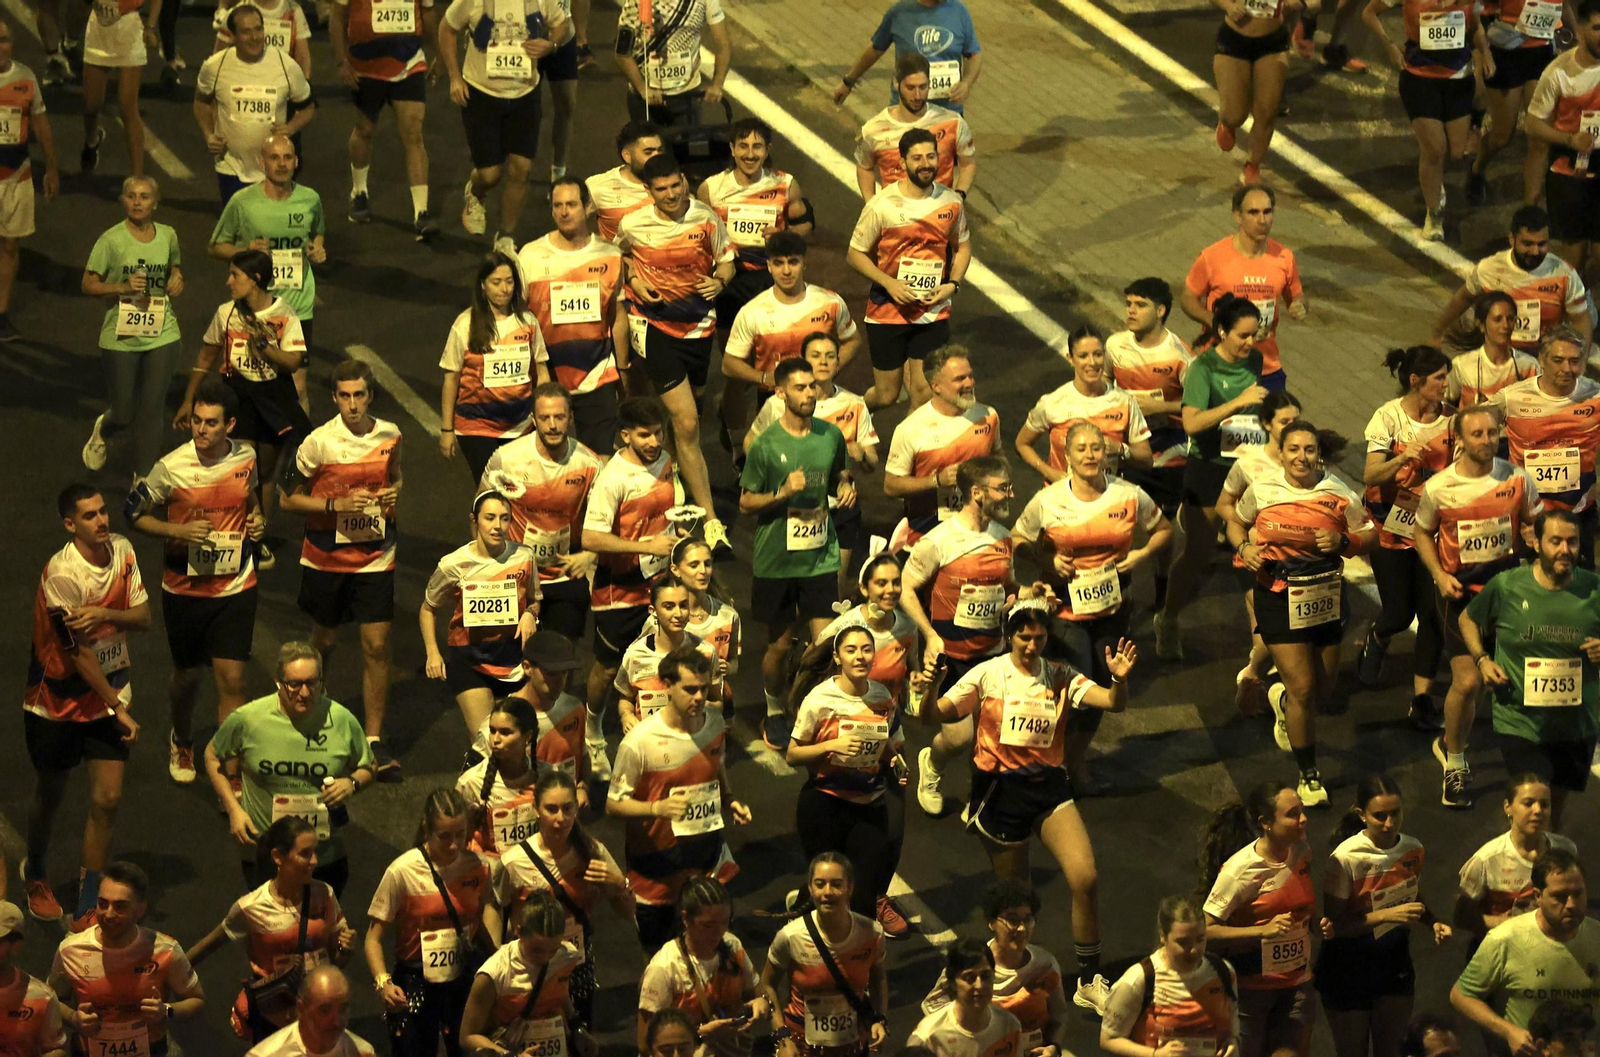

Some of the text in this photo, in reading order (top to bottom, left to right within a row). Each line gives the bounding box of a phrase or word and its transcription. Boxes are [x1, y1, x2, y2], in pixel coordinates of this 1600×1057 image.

[377, 10, 409, 22] 24739
[1428, 27, 1455, 39] 8840
[264, 35, 284, 47] 063
[495, 55, 523, 66] 5142
[653, 66, 686, 78] 13280
[928, 78, 952, 90] 844
[236, 100, 271, 113] 17388
[733, 220, 769, 234] 18977
[273, 266, 294, 279] 312
[902, 274, 937, 289] 12468
[1244, 276, 1266, 284] XXXV
[561, 298, 590, 311] 5416
[126, 312, 155, 325] 2915
[493, 361, 521, 375] 5418
[1574, 405, 1595, 417] KH7
[1536, 467, 1568, 481] 3471
[343, 516, 380, 531] 19045
[1465, 533, 1506, 551] 20798
[195, 549, 235, 563] 19577
[507, 570, 525, 580] KH7
[1075, 581, 1114, 602] 16566
[469, 598, 510, 614] 20281
[967, 602, 998, 616] 9284
[1295, 598, 1334, 617] 13928
[1531, 678, 1575, 692] 17353
[1010, 716, 1051, 734] 17482
[258, 760, 328, 777] sano
[687, 801, 715, 820] 9204
[1272, 940, 1304, 960] 8593
[813, 1015, 853, 1032] 18925
[100, 1039, 138, 1057] 7444
